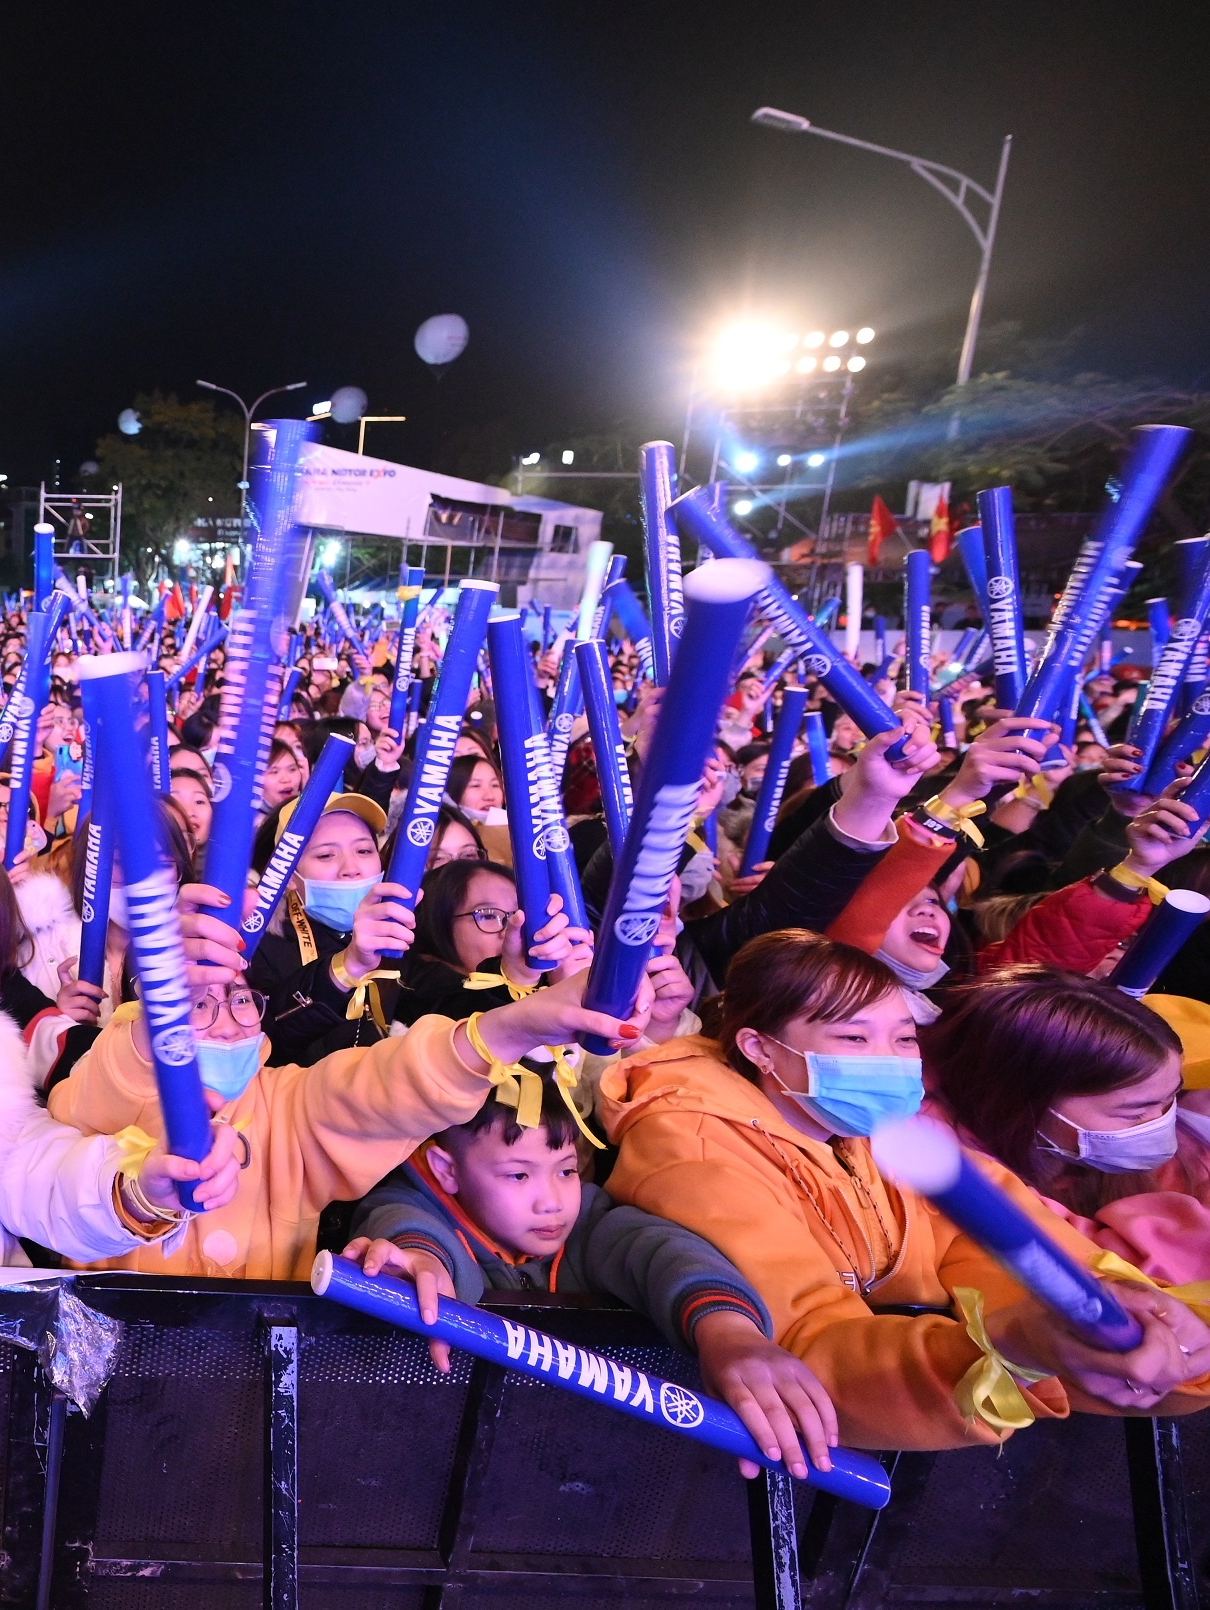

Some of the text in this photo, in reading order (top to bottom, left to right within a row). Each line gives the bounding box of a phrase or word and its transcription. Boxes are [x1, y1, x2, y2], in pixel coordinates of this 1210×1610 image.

[398, 626, 417, 677] YAMAHA
[989, 604, 1019, 676] YAMAHA
[1144, 640, 1192, 710] YAMAHA
[413, 714, 463, 815] YAMAHA
[769, 759, 791, 817] YAMAHA
[83, 822, 102, 900] YAMAHA
[256, 831, 305, 910] YAMAHA
[290, 902, 313, 949] OFF-WHITE
[501, 1319, 655, 1414] YAMAHA
